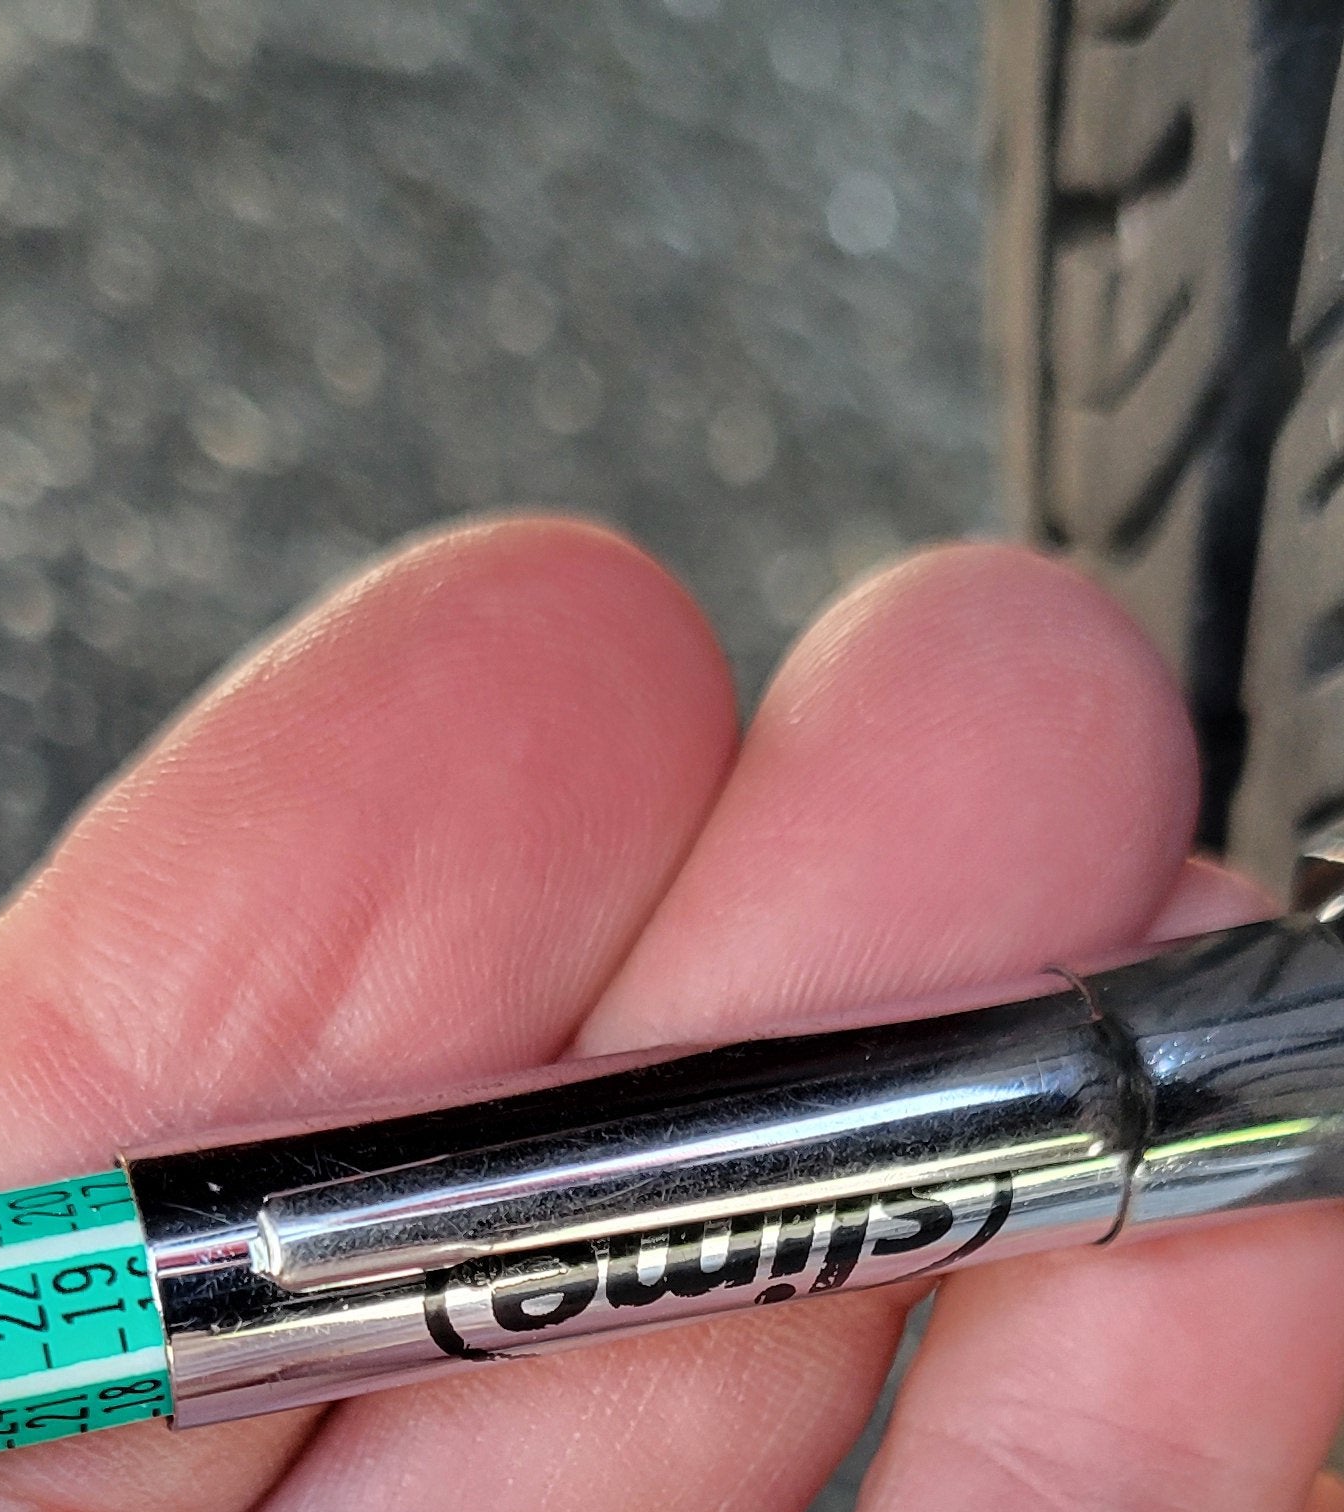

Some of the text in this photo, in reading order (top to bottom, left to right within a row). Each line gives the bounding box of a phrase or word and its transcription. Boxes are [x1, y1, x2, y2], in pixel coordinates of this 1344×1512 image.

[8, 1190, 76, 1226] 20
[52, 1262, 126, 1325] 19
[25, 1394, 89, 1429] 21
[98, 1379, 166, 1413] 18
